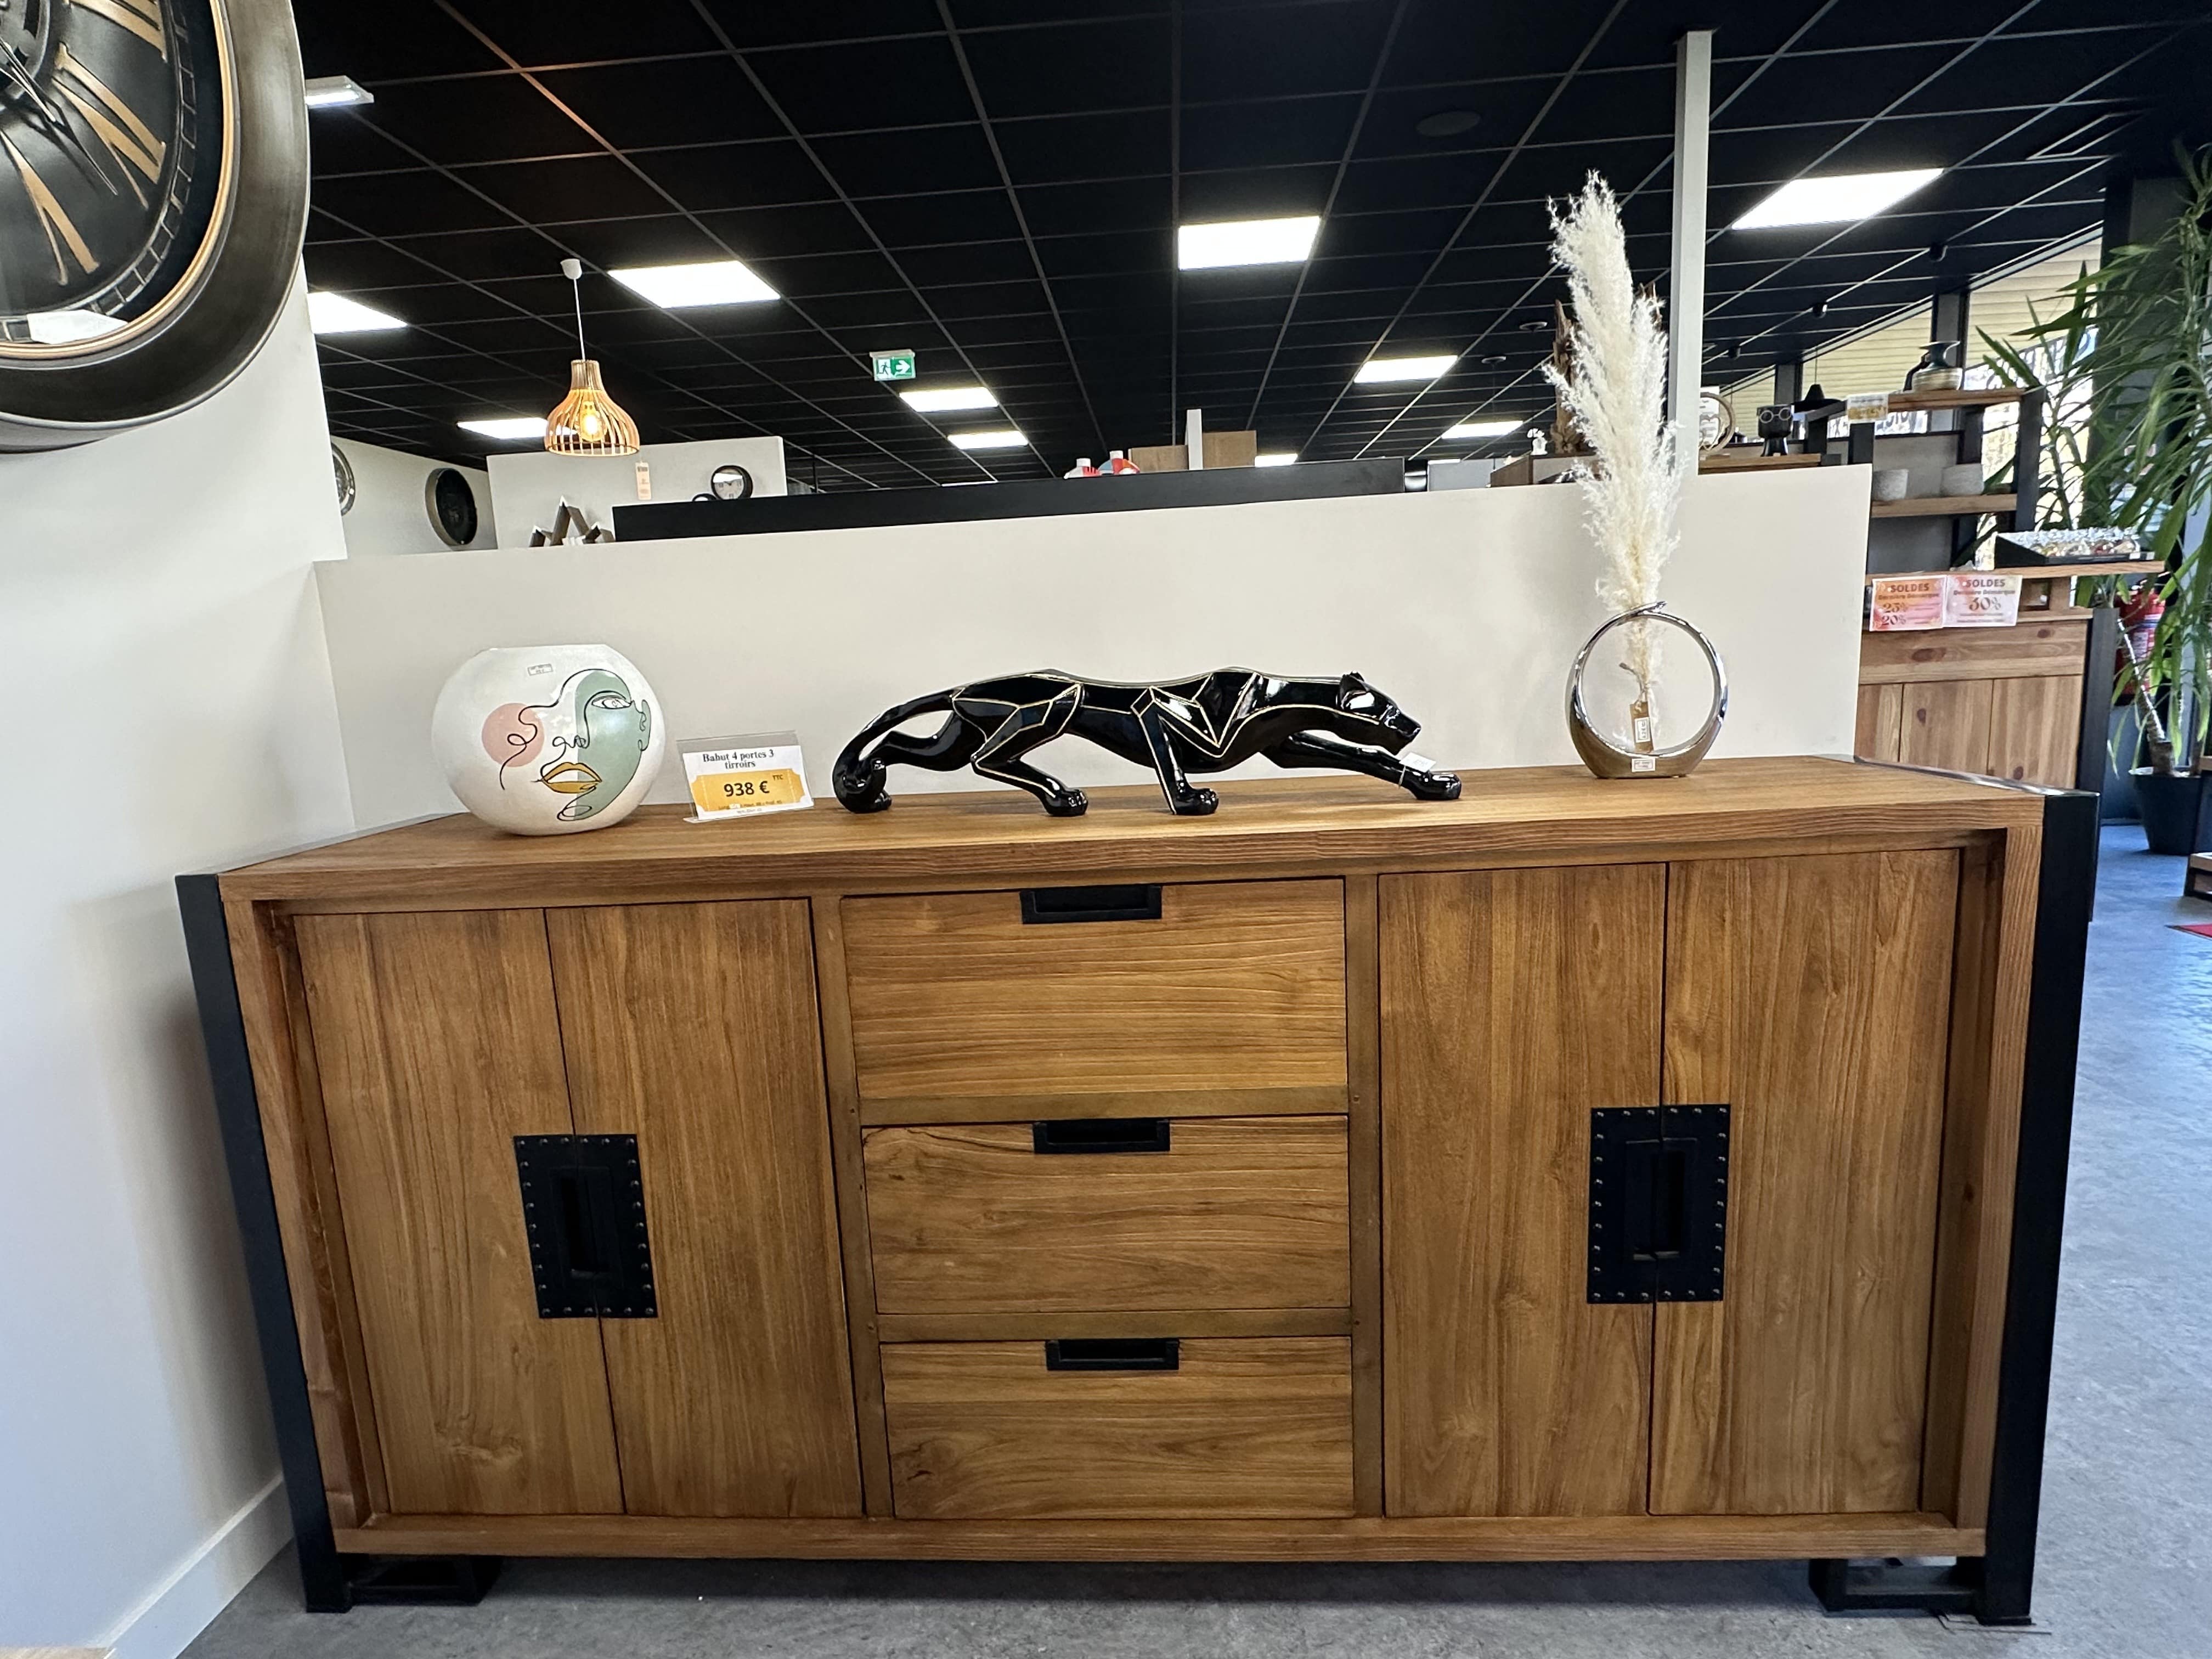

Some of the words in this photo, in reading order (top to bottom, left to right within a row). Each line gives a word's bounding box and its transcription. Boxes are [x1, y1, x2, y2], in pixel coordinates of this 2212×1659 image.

[1890, 583, 1930, 593] SOLDES
[1967, 579, 2006, 588] SOLDES
[703, 753, 730, 762] Bahut
[732, 752, 737, 760] 4
[740, 752, 767, 761] portes
[768, 749, 774, 758] 3
[725, 760, 756, 769] tirroirs
[724, 782, 755, 797] 938
[759, 780, 770, 794] €
